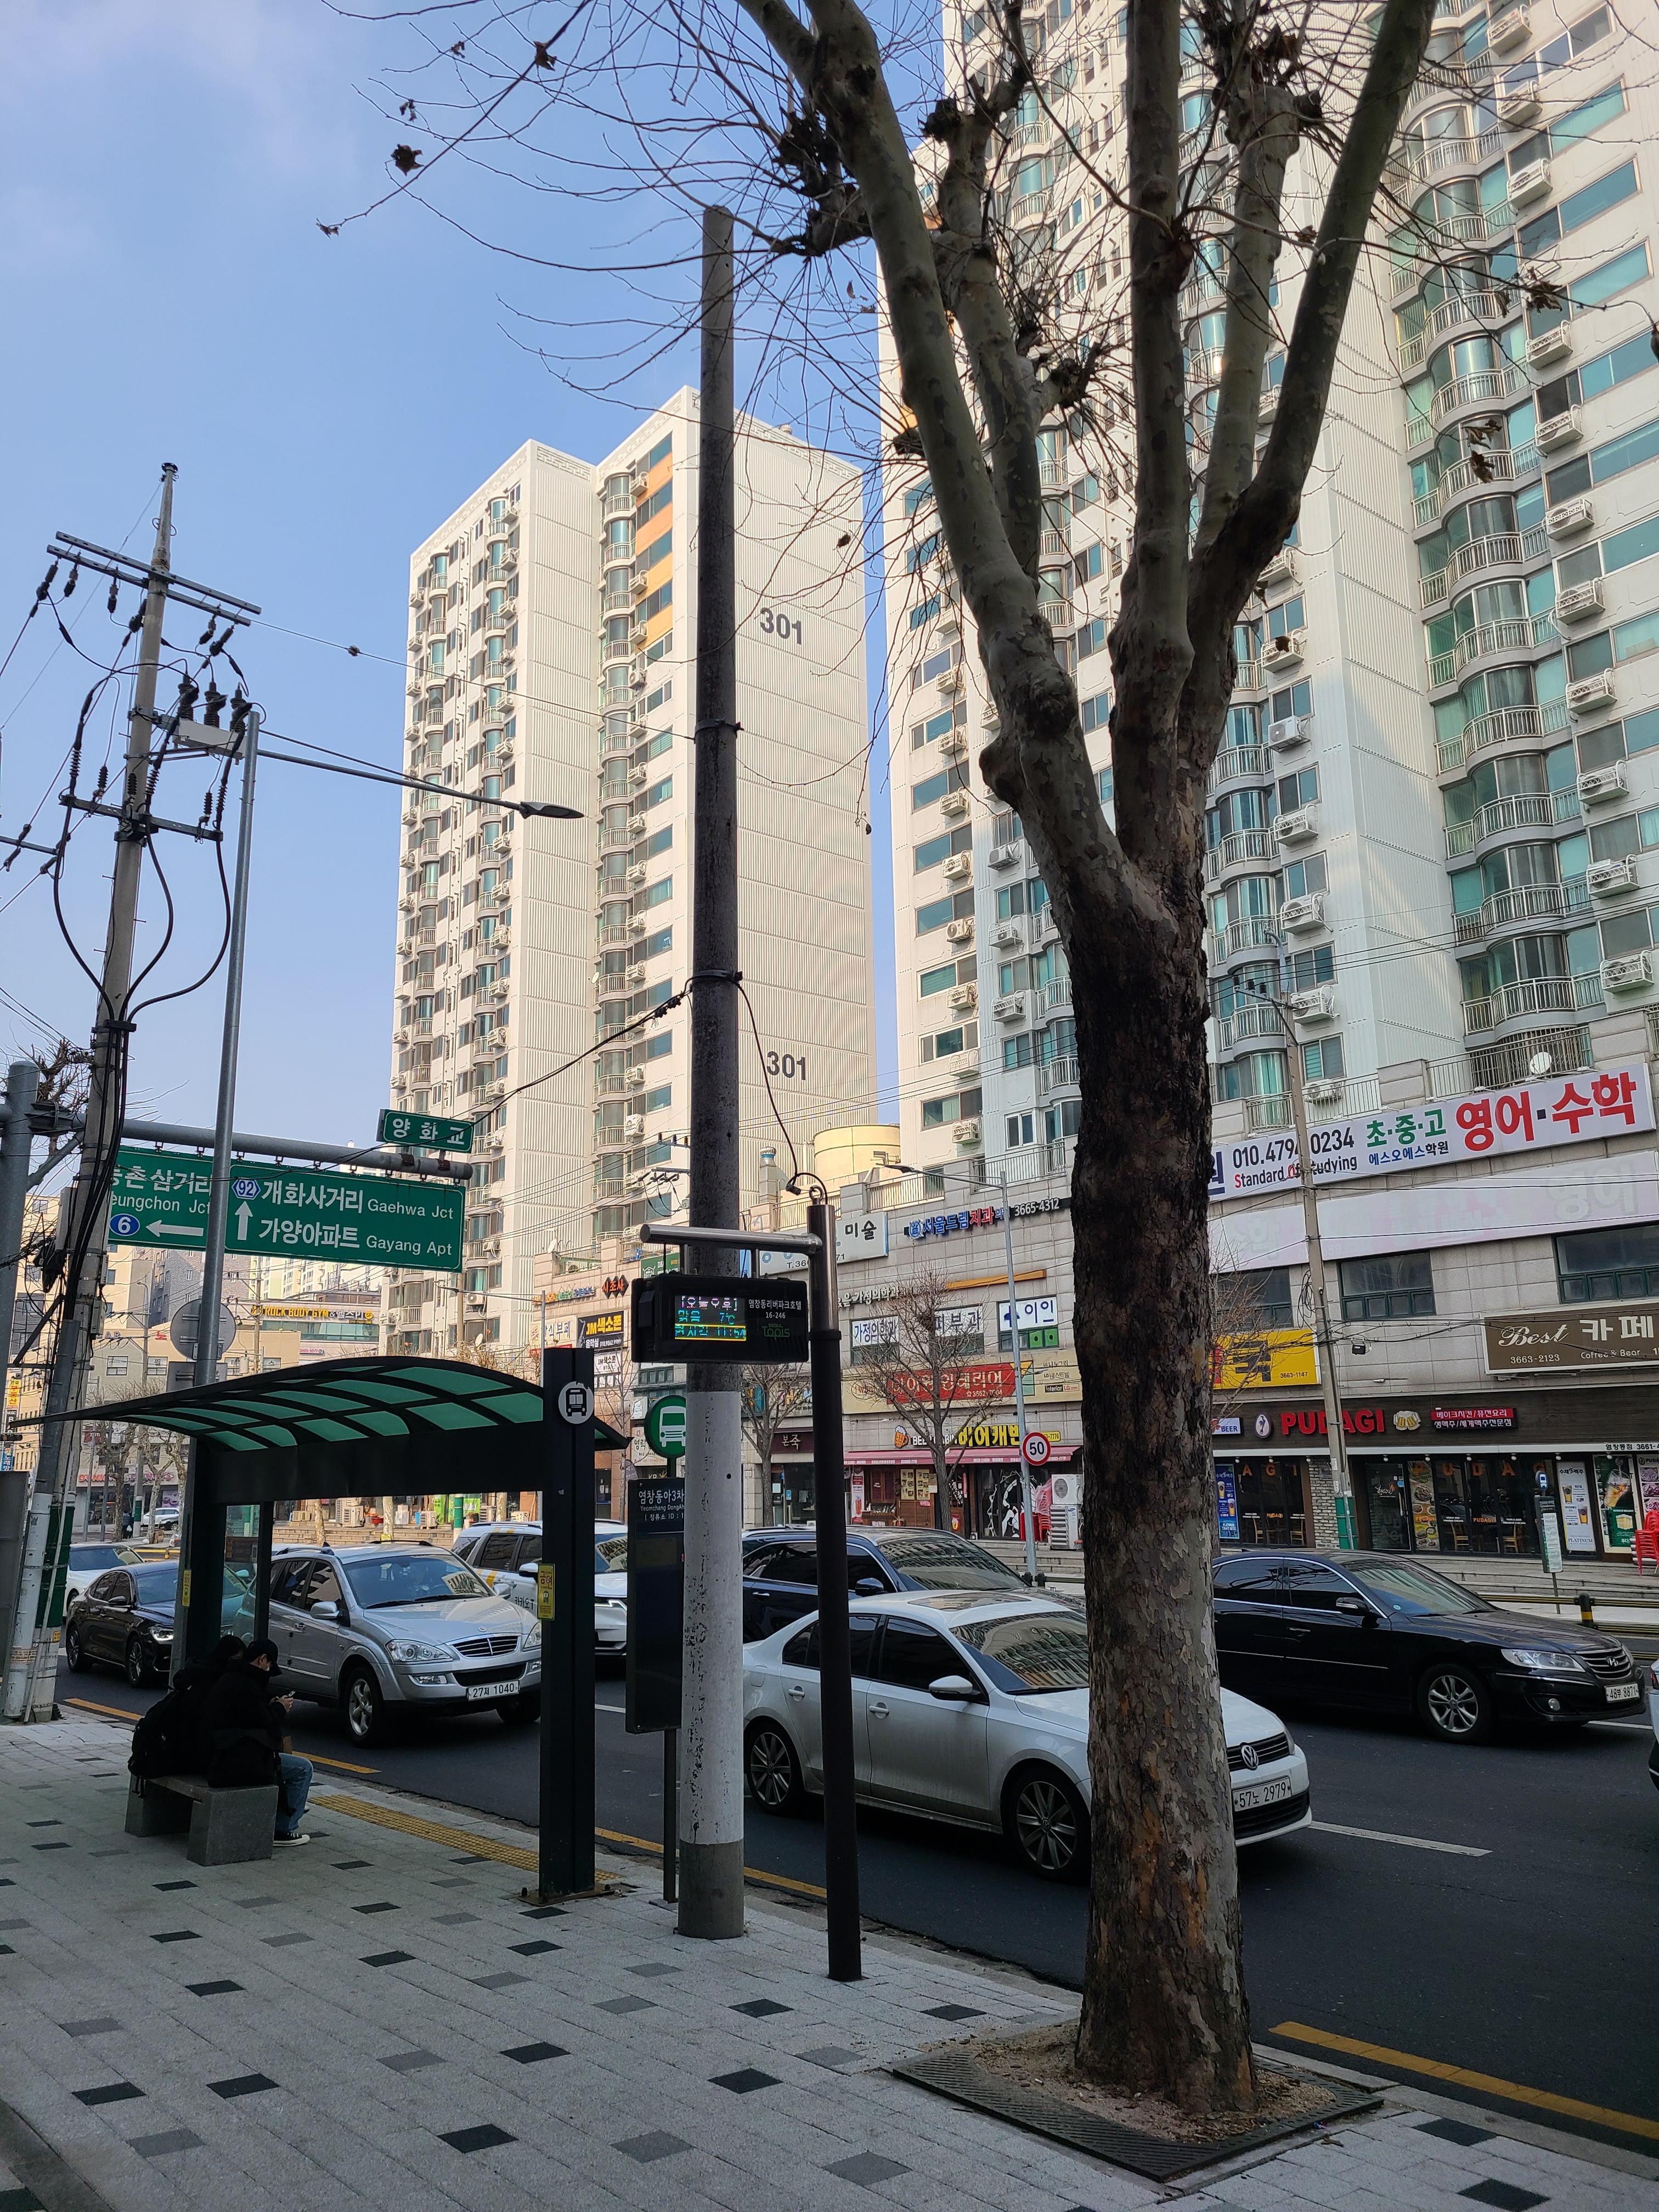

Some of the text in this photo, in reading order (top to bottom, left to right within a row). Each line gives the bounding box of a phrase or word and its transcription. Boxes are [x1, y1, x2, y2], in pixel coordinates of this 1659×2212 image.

[760, 607, 802, 645] 301
[766, 1051, 805, 1080] 301
[393, 1119, 464, 1145] 양화교
[1233, 1127, 1354, 1169] 010.4790234
[1369, 1141, 1449, 1166] 에스오에스학원
[1234, 1165, 1284, 1188] Standard
[1311, 1155, 1358, 1176] tudying
[238, 1180, 254, 1197] 92
[262, 1180, 363, 1213] 개화사거리
[112, 1192, 180, 1212] eungchon
[368, 1199, 454, 1220] Gaehwa Jct
[1015, 1198, 1059, 1217] 3665-4312
[119, 1216, 131, 1234] 6
[259, 1218, 360, 1248] 가양아파트
[845, 1220, 877, 1241] 미술
[366, 1234, 452, 1256] Gayang Apt
[602, 1280, 624, 1292] 시조사
[265, 1306, 286, 1316] ROCK
[289, 1307, 309, 1317] BODY
[312, 1308, 329, 1318] GYM
[748, 1299, 802, 1310] 염창동리버파크호텔
[1498, 1316, 1654, 1347] Best 카페
[1510, 1353, 1560, 1364] 3663-2123
[1280, 1408, 1385, 1435] PUDAGI
[781, 1434, 802, 1451] 본죽
[1029, 1441, 1045, 1455] 50
[639, 1488, 685, 1504] 염창동아3차
[650, 1513, 666, 1521] 정류소
[473, 1683, 515, 1697] 27저 1040
[1623, 1686, 1637, 1697] 8871
[1239, 1782, 1286, 1808] 57노 2979
